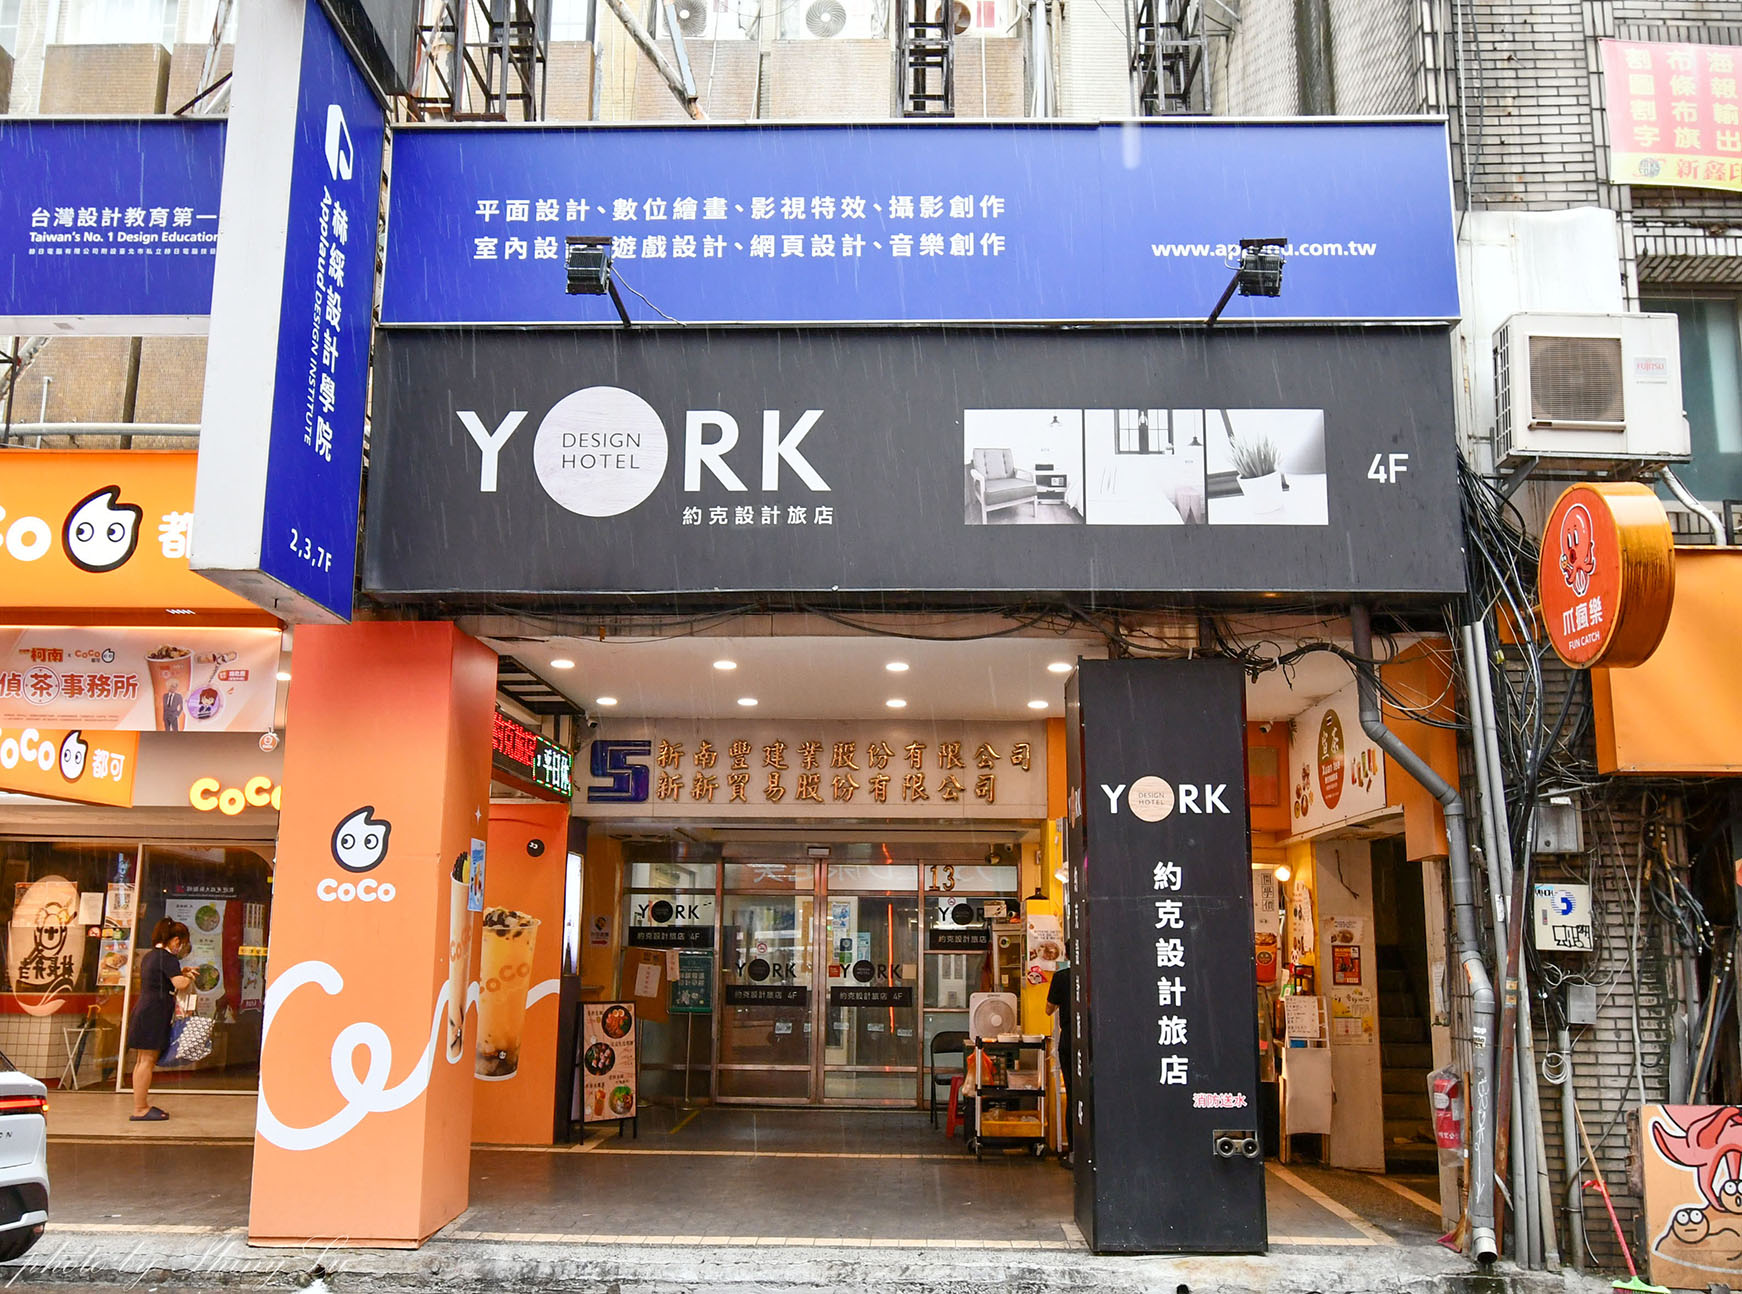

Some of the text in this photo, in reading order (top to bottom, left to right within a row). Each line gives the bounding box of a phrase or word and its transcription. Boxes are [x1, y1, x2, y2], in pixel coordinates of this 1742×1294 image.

[31, 207, 217, 227] 台灣設計教育第一
[30, 231, 81, 242] Taiwan's
[83, 231, 103, 242] No.
[108, 231, 113, 242] 1
[117, 231, 158, 245] Design
[474, 232, 1006, 260] 室內設遊戲設計、網頁設計、音樂創作
[1151, 241, 1377, 259] www.apu.com.tw
[304, 185, 333, 447] Applaud DESIGN INSTITUTE
[561, 432, 641, 448] DESIGN
[561, 454, 641, 469] HOTEL
[1367, 453, 1409, 484] 4F
[682, 506, 834, 526] 約克設計旅店
[290, 528, 332, 572] 2,3,7F
[1568, 631, 1600, 650] FUN CATCH
[31, 647, 63, 662] 柯南
[0, 728, 55, 771] oCo
[656, 739, 1032, 772] 新南豐建業股份有限公司
[92, 748, 125, 782] 都可
[656, 773, 998, 803] 新新貿易股份有限公司
[317, 878, 396, 902] CoCo
[928, 864, 956, 892] 13
[1153, 861, 1189, 1087] 約克設計旅店
[1193, 1092, 1248, 1109] 消防送水
